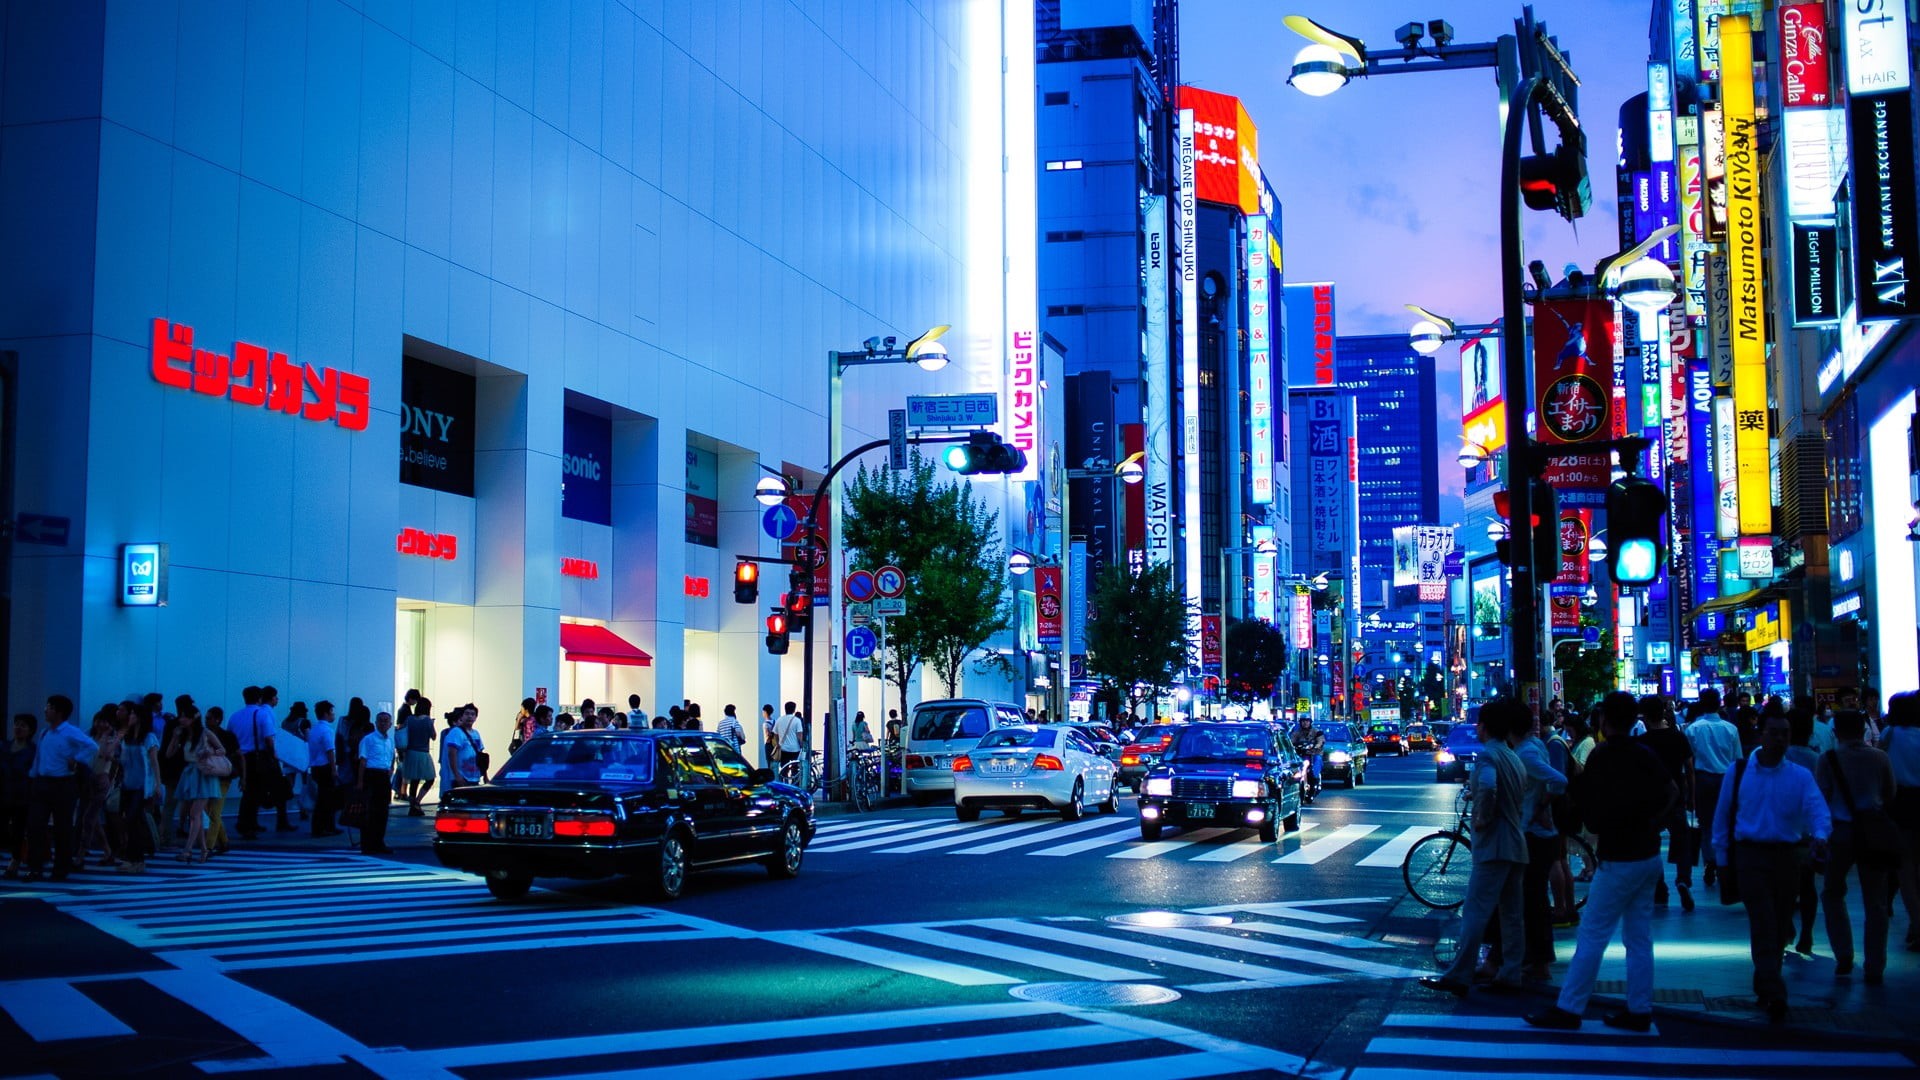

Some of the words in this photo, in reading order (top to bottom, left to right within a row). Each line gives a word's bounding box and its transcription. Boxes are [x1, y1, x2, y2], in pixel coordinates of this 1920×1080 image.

[1784, 8, 1802, 59] Ginza
[1786, 60, 1805, 103] Calla
[1861, 70, 1897, 85] HAIR
[1194, 121, 1236, 140] カラオケ
[1209, 139, 1218, 150] &
[1876, 101, 1891, 180] EXCHANGE
[1182, 137, 1192, 189] MEGANE
[1183, 196, 1193, 216] TOP
[1881, 182, 1894, 247] ARMANI
[1184, 219, 1194, 281] SHINJUKU
[1808, 231, 1819, 264] EIGHT
[1737, 207, 1757, 340] Matsumoto
[1810, 267, 1822, 314] MILLION
[152, 317, 370, 430] ビックカメラ
[1556, 382, 1581, 394] 新宿
[1014, 331, 1032, 450] ビックカメラ
[1548, 394, 1602, 415] エイサー
[1693, 371, 1712, 413] AOKI
[911, 401, 990, 414] 新宿三丁目西
[1315, 400, 1334, 418] B1
[1739, 410, 1764, 431] 薬
[1561, 413, 1597, 433] まつり
[1313, 425, 1338, 453] 酒
[563, 453, 600, 481] sonic
[1314, 459, 1326, 550] 日本酒・焼酎など
[1327, 459, 1339, 543] ワイン・ビール
[1151, 482, 1167, 556] WATCH.
[1420, 529, 1452, 549] カラオケ
[1743, 550, 1770, 558] ネイル
[1432, 550, 1440, 561] の
[1743, 561, 1770, 569] サロン
[1074, 553, 1083, 598] DIAMOND
[1074, 600, 1083, 644] SHIRAISHI
[852, 636, 864, 655] P
[861, 646, 870, 655] 40
